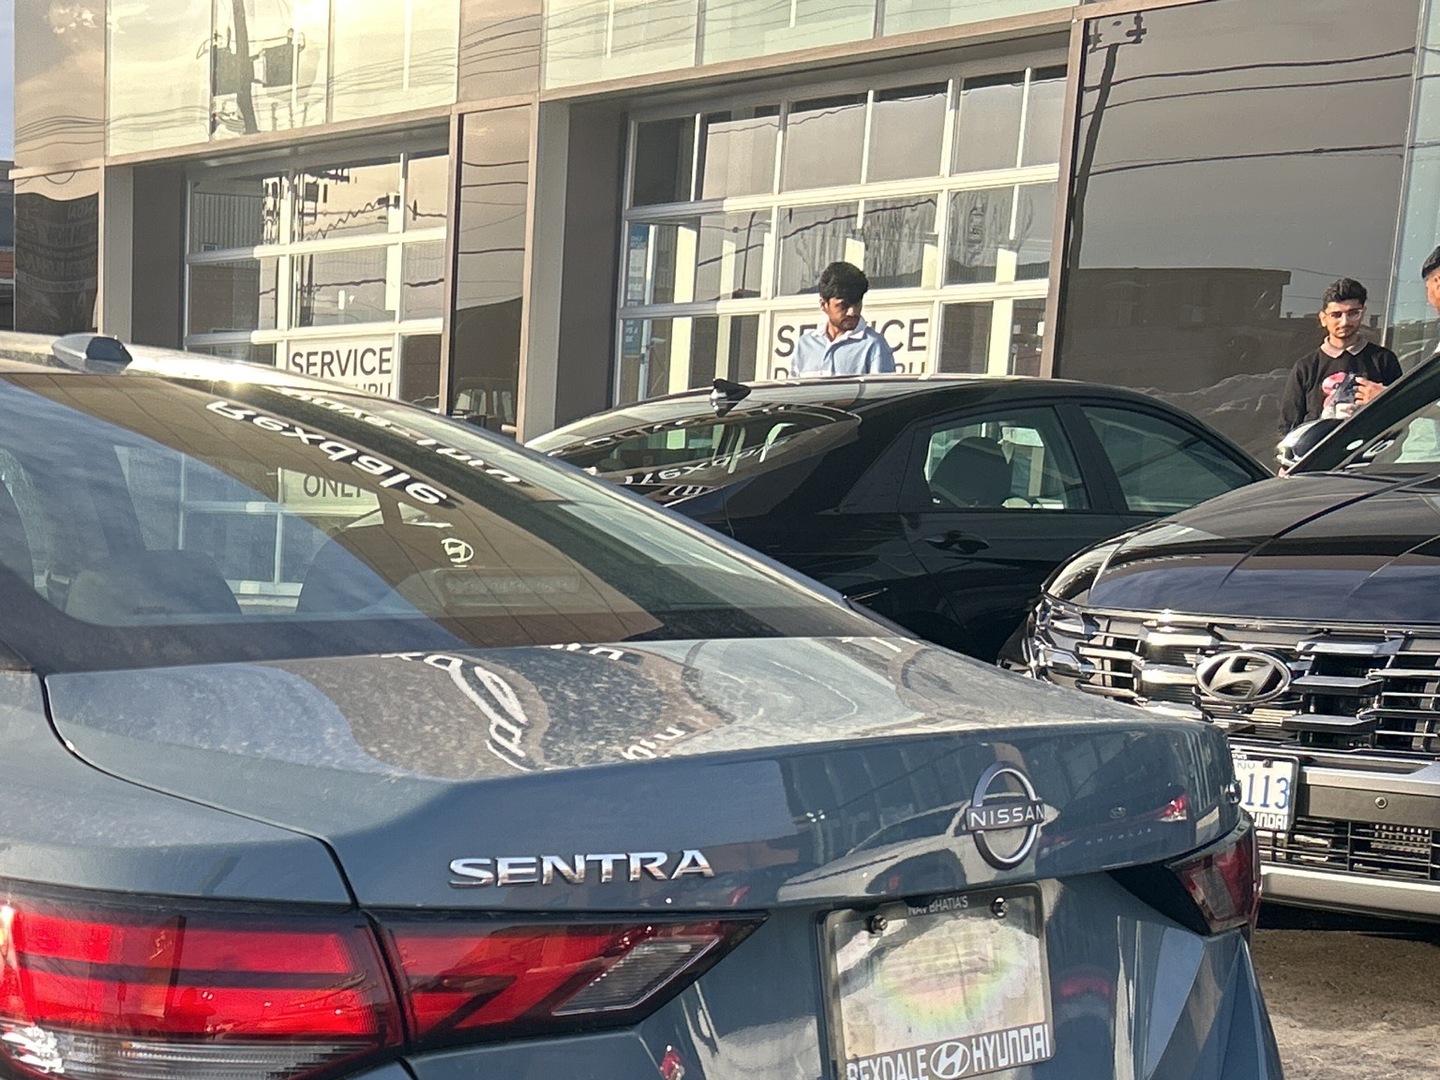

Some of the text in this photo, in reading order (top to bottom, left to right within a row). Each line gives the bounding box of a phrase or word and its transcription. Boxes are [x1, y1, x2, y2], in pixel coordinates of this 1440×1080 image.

[291, 346, 393, 378] SERVICE
[969, 803, 1046, 828] NISSAN
[448, 850, 716, 889] SENTRA
[971, 1023, 1051, 1072] HYUNDAI
